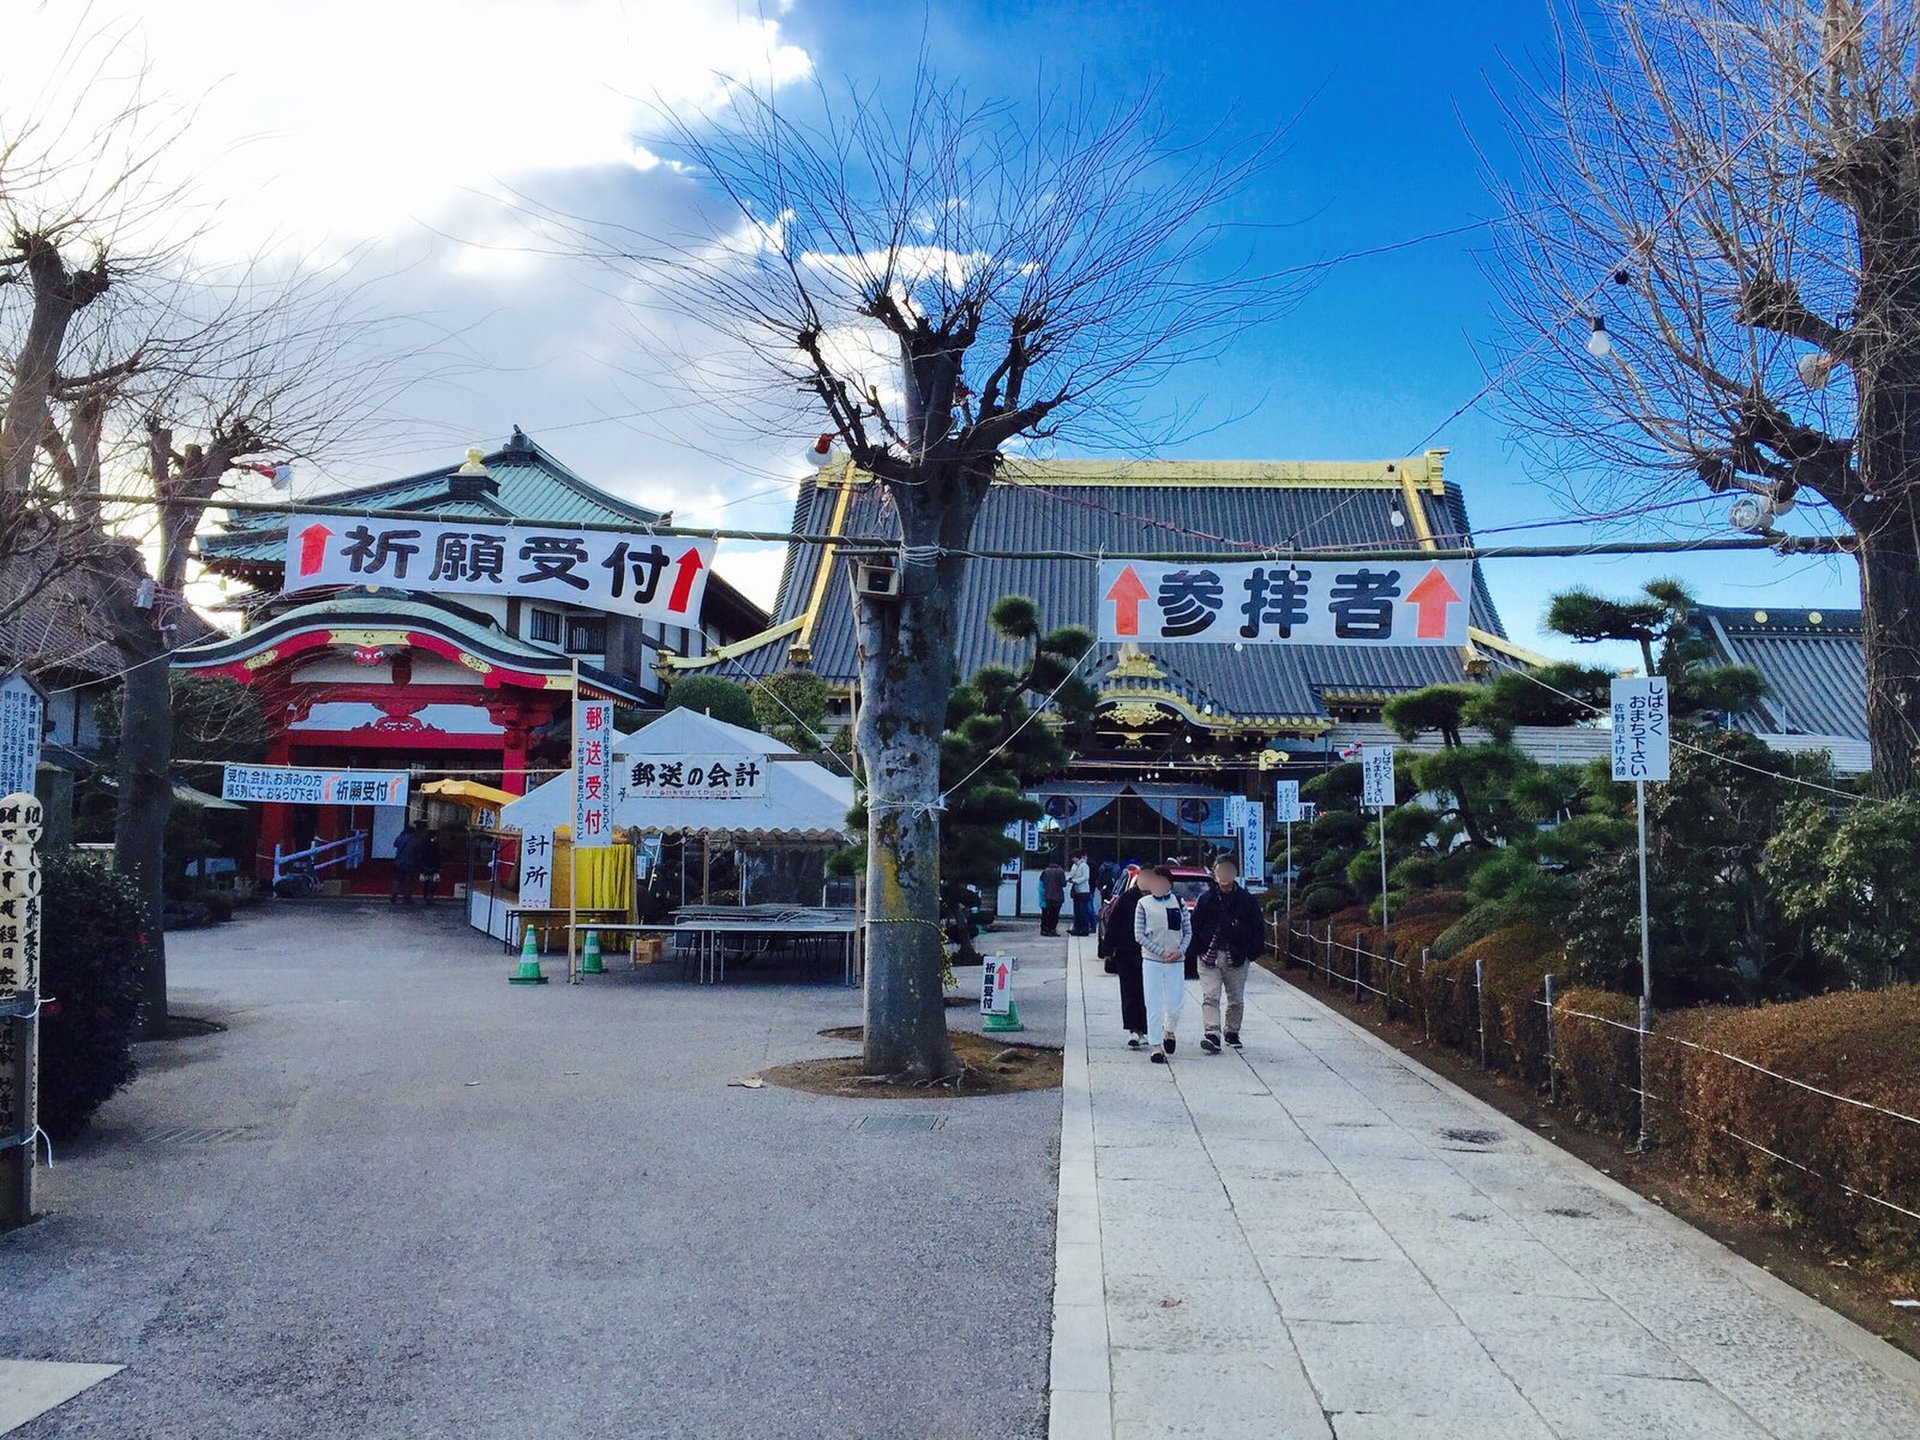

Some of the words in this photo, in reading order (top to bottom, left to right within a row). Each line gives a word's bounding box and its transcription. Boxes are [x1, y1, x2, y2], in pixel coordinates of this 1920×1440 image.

[340, 525, 670, 604] 祈願受付
[1157, 567, 1402, 640] 参拝者
[1614, 703, 1626, 777] 佐野厄よけ大師
[1629, 696, 1647, 777] おまち下さい
[1648, 681, 1664, 736] しばらく
[336, 780, 389, 801] 祈願受付
[585, 706, 602, 836] 郵送受付
[631, 761, 760, 788] 郵送の会計
[1383, 748, 1392, 780] しばらく
[1247, 807, 1257, 876] 大師おみくじ
[983, 962, 996, 1009] 祈願受付
